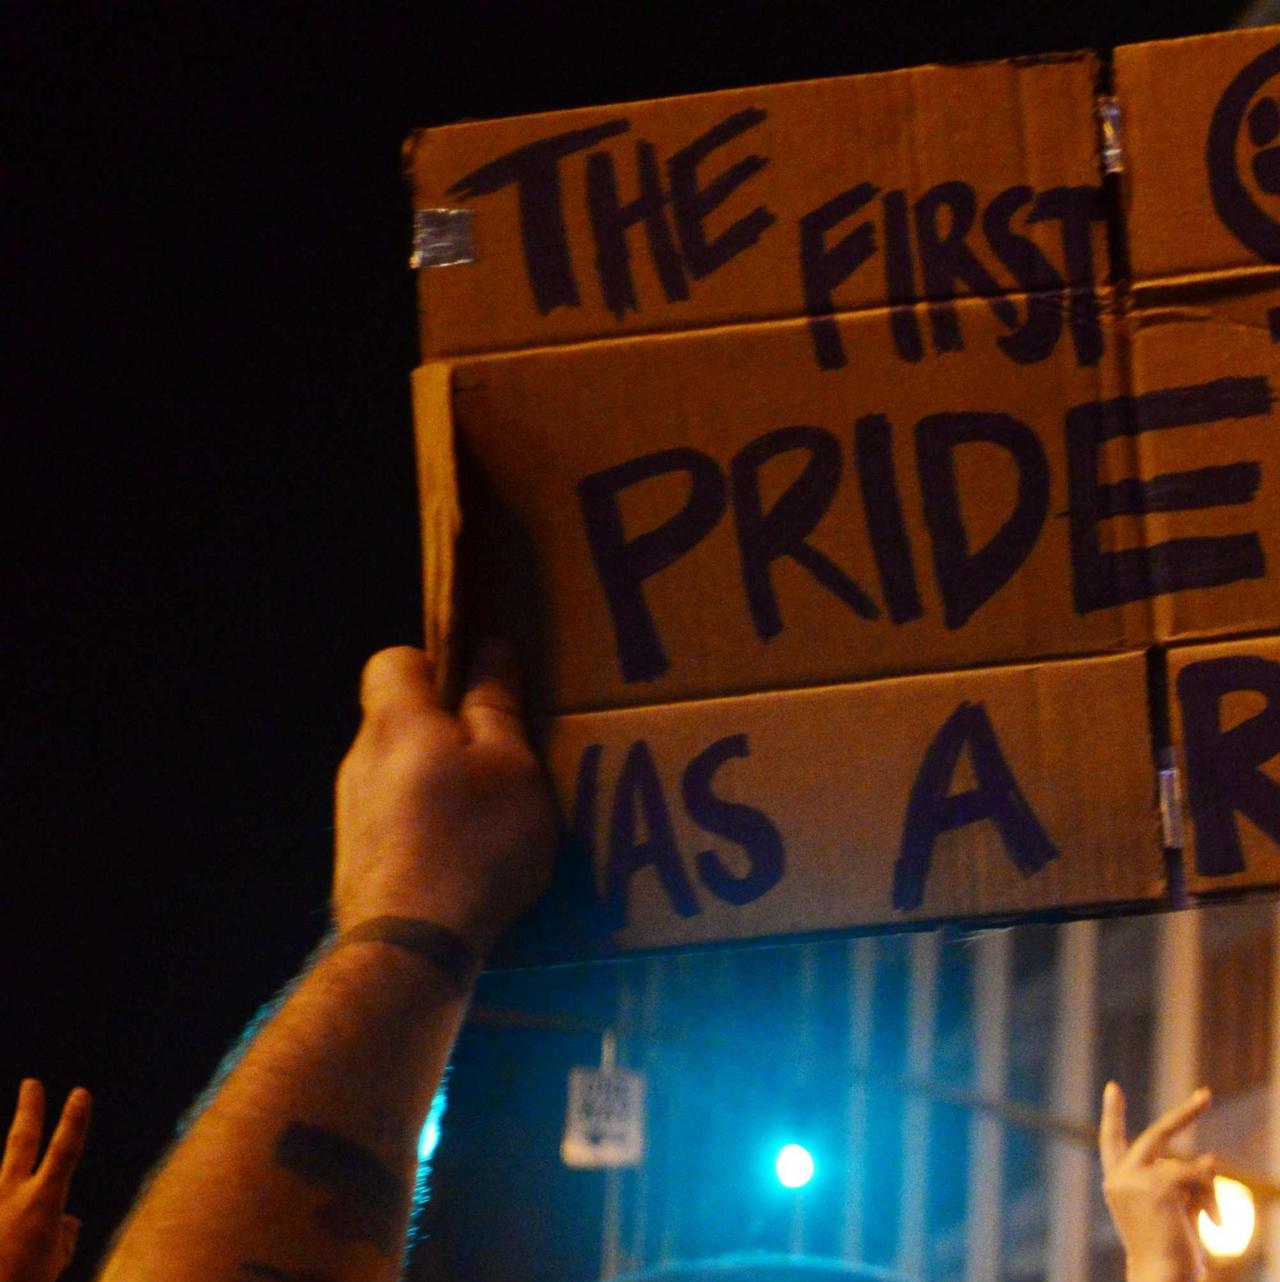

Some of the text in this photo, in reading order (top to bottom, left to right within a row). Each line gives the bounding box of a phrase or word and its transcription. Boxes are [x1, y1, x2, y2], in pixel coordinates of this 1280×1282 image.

[447, 107, 776, 320] THE
[799, 182, 1105, 370] FIRST
[577, 375, 1276, 684] PRIDE
[892, 701, 1061, 912] A
